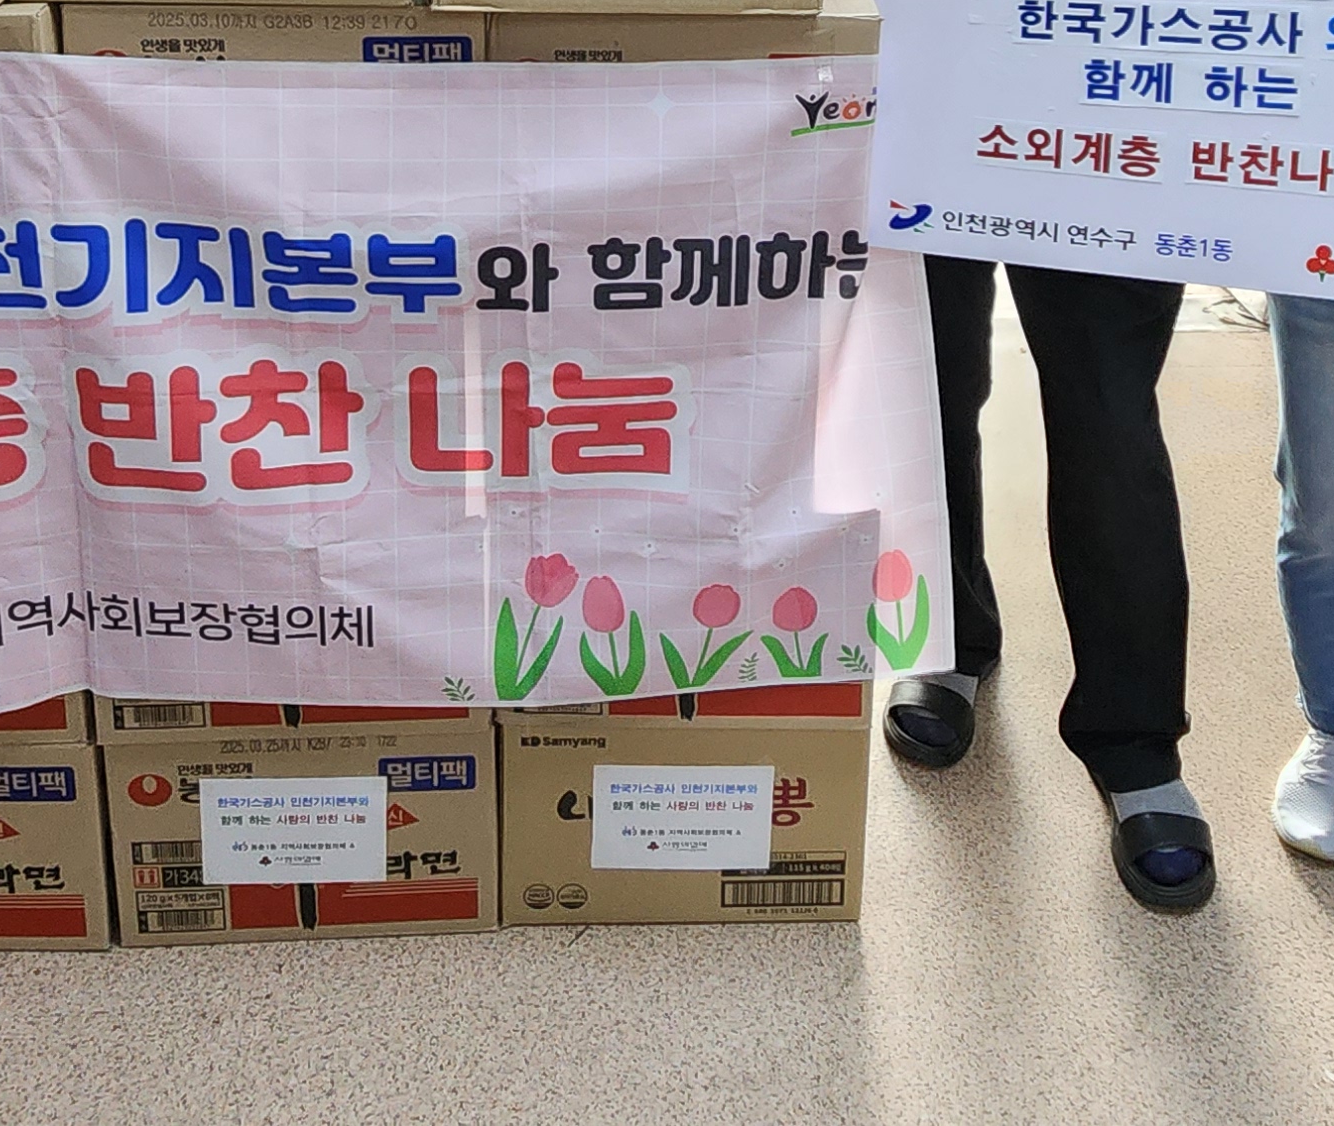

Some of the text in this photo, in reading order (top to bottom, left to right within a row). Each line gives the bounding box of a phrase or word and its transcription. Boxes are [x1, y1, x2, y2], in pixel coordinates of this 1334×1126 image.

[322, 15, 366, 31] 12:39
[371, 14, 418, 31] 2170
[1083, 60, 1299, 110] 함께 하는
[975, 124, 1162, 178] 소외계층
[941, 209, 1233, 263] 인천광역시 연수구 동춘1동
[76, 359, 365, 493] 반찬
[407, 359, 677, 479] 나눔
[542, 735, 607, 749] Samyang
[387, 759, 468, 786] 멀티팩
[609, 782, 759, 795] 한국가스공사 인천기지본부와
[611, 798, 755, 812] 함께 하는 사랑의 반찬 나눔
